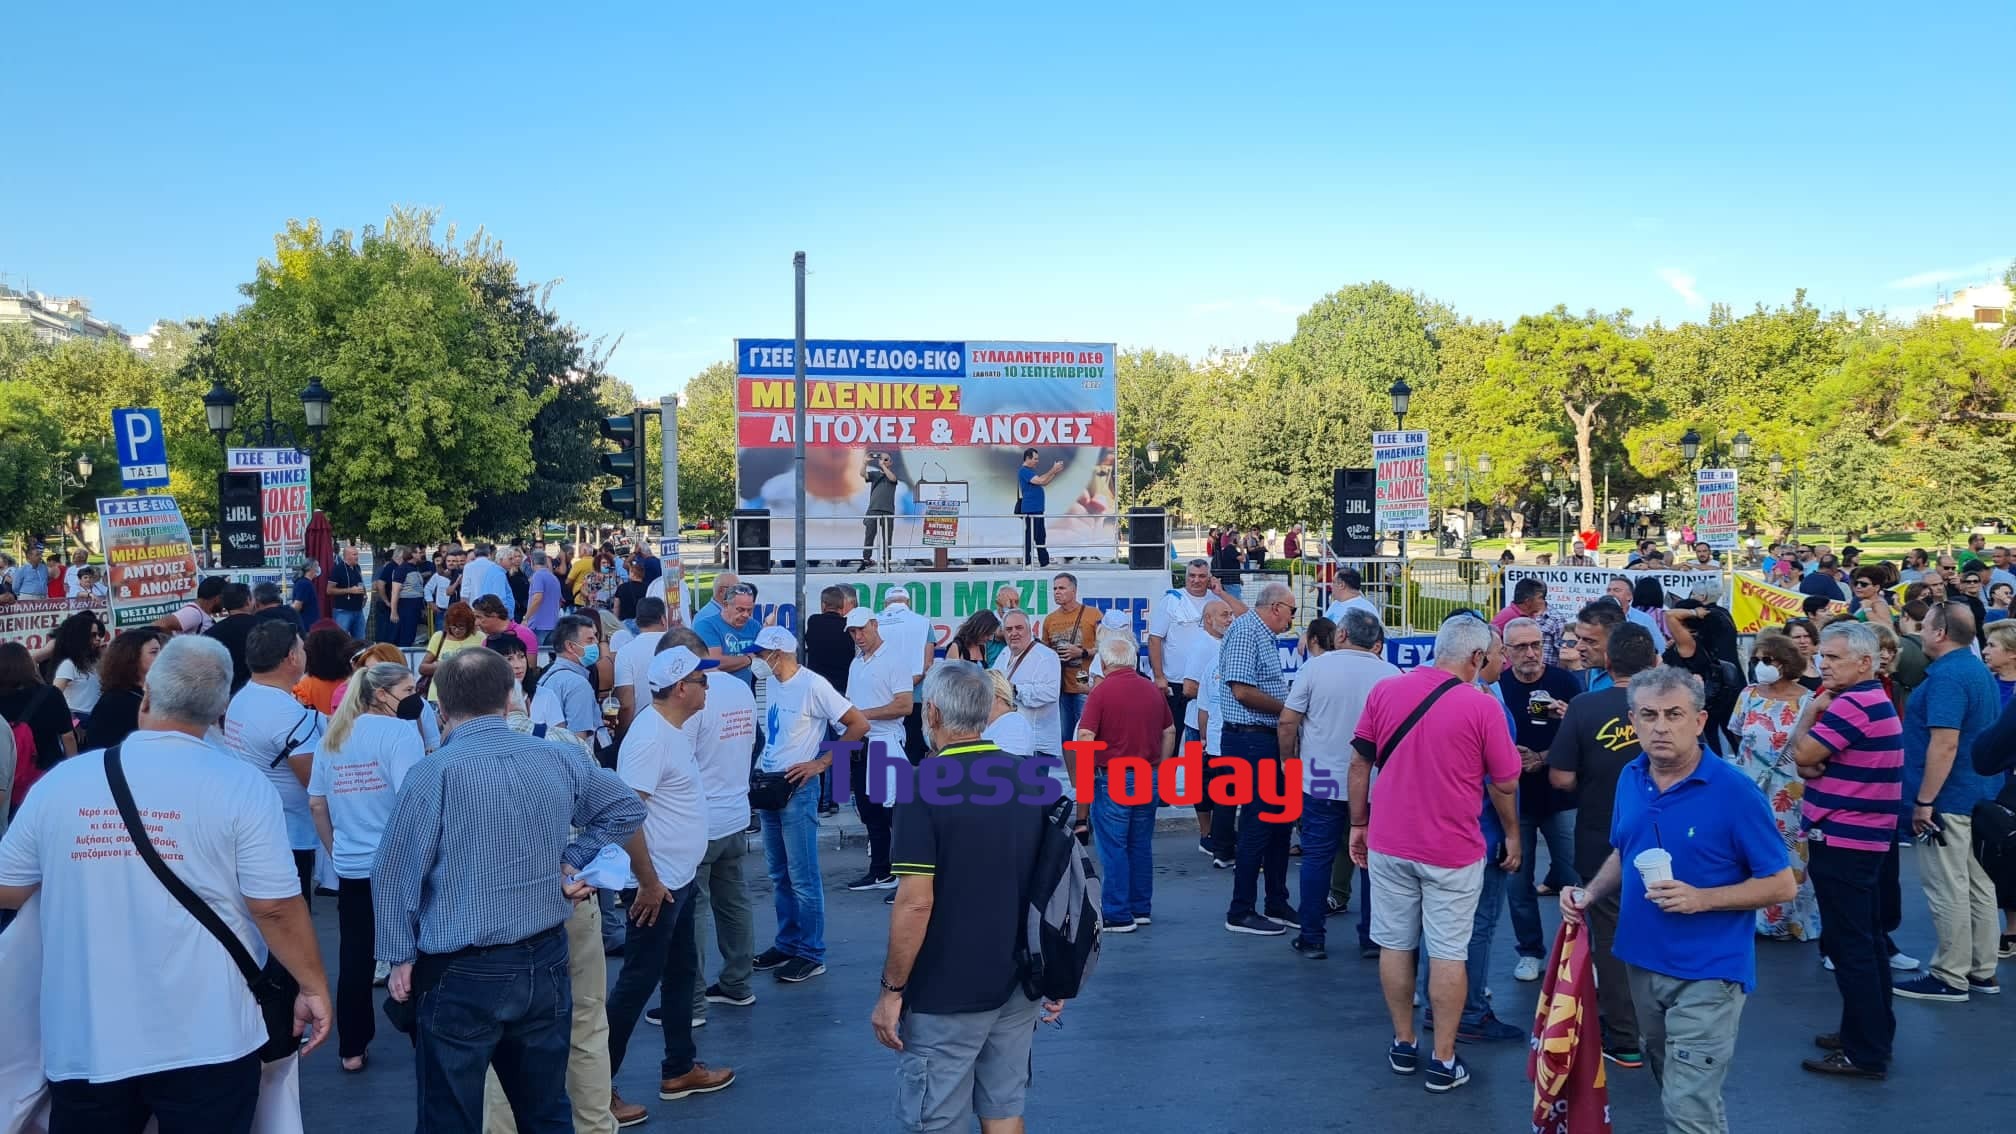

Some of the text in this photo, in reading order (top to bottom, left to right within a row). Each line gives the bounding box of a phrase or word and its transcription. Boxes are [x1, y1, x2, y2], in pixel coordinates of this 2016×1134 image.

[749, 347, 961, 371] ΓΣΕΕΑΔΕΔΥ-ΕΔΟΘ-ΕΚΘ
[972, 350, 1103, 364] ΣΥΛΛΑΛΗΤΗΡΙΟ ΔΕΘ
[1004, 365, 1018, 378] 10
[1020, 365, 1105, 378] ΣΕΠΤΕΜΒΡΙΟΥ
[125, 412, 153, 461] P
[930, 417, 953, 444] &
[970, 416, 1093, 445] ΑΝΟΧΕΣ
[1378, 434, 1397, 444] ΓΣΕΕ
[1405, 433, 1423, 443] ΕΚΘ
[235, 452, 264, 465] ΓΣΕΕ
[276, 450, 303, 465] ΕΚΘ
[1376, 445, 1425, 460] ΜΗΔΕΝΙΚΕΣ
[130, 466, 159, 478] ΤΑΞΙ
[263, 468, 307, 486] ΕΝΙΚΕΣ
[1378, 458, 1425, 481] ΑΝΤΟΧΕΣ
[1376, 478, 1425, 500] & ΑΝΟΧΕΣ
[103, 499, 175, 514] ΓΣΕΕ-ΕΚΘ
[261, 485, 307, 514] ΤΟΧΕΣ
[1345, 499, 1371, 514] JBL
[1700, 492, 1734, 509] ΑΝΤΟΧΕΣ
[226, 505, 257, 521] JBL
[1706, 508, 1734, 526] ΑΝΟΧΕΣ
[263, 513, 308, 543] ΝΟΧΕΣ
[111, 543, 190, 563] ΜΗΔΕΝΙΚΕΣ
[123, 560, 187, 579] ΑΝΤΟΧΕΣ
[1508, 570, 1568, 583] ΕΡΓΑΤΙΚΟ
[120, 578, 192, 598] & ΑΝΟΧΕΣ
[78, 807, 101, 818] Νερό
[71, 847, 122, 861] εργαζόμενοι
